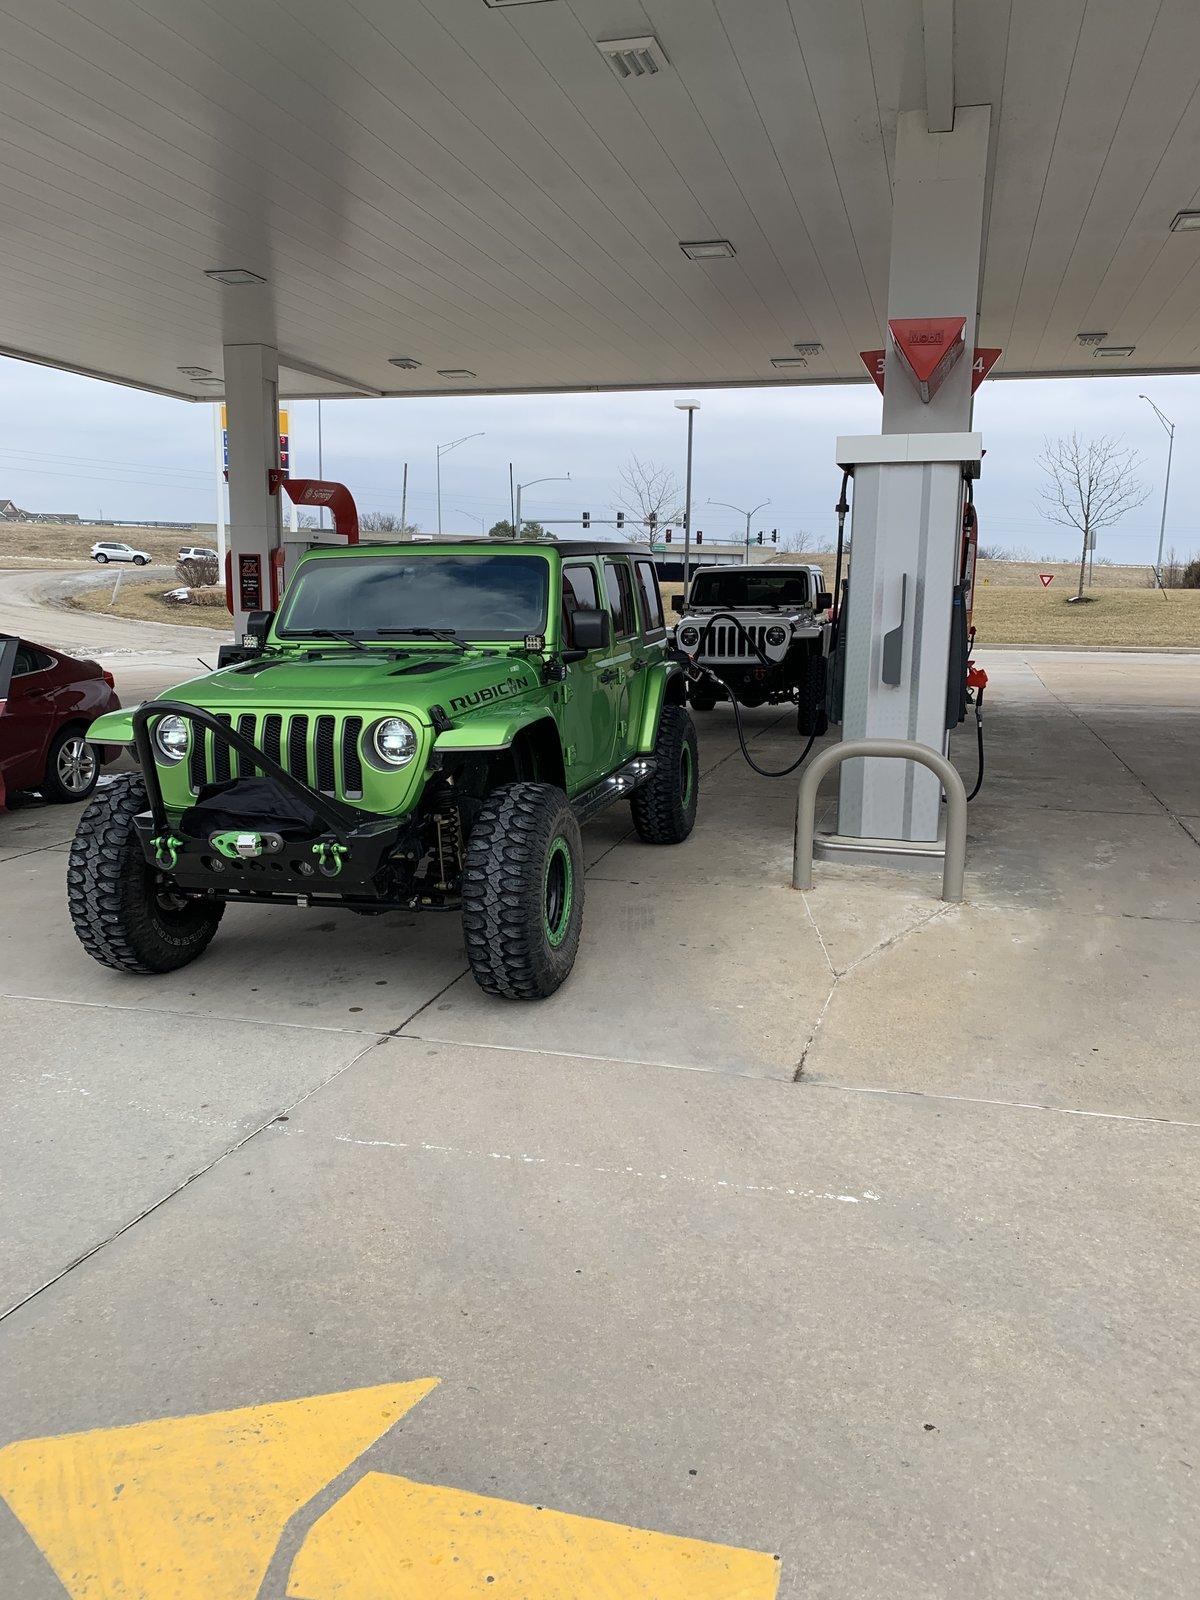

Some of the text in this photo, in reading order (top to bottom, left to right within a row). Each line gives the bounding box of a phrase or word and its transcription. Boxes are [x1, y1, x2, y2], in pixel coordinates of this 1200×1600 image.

[908, 330, 944, 345] Mobil
[876, 359, 886, 374] 3
[973, 357, 985, 373] 4
[313, 488, 334, 501] Synergy
[449, 676, 529, 712] RUBICON
